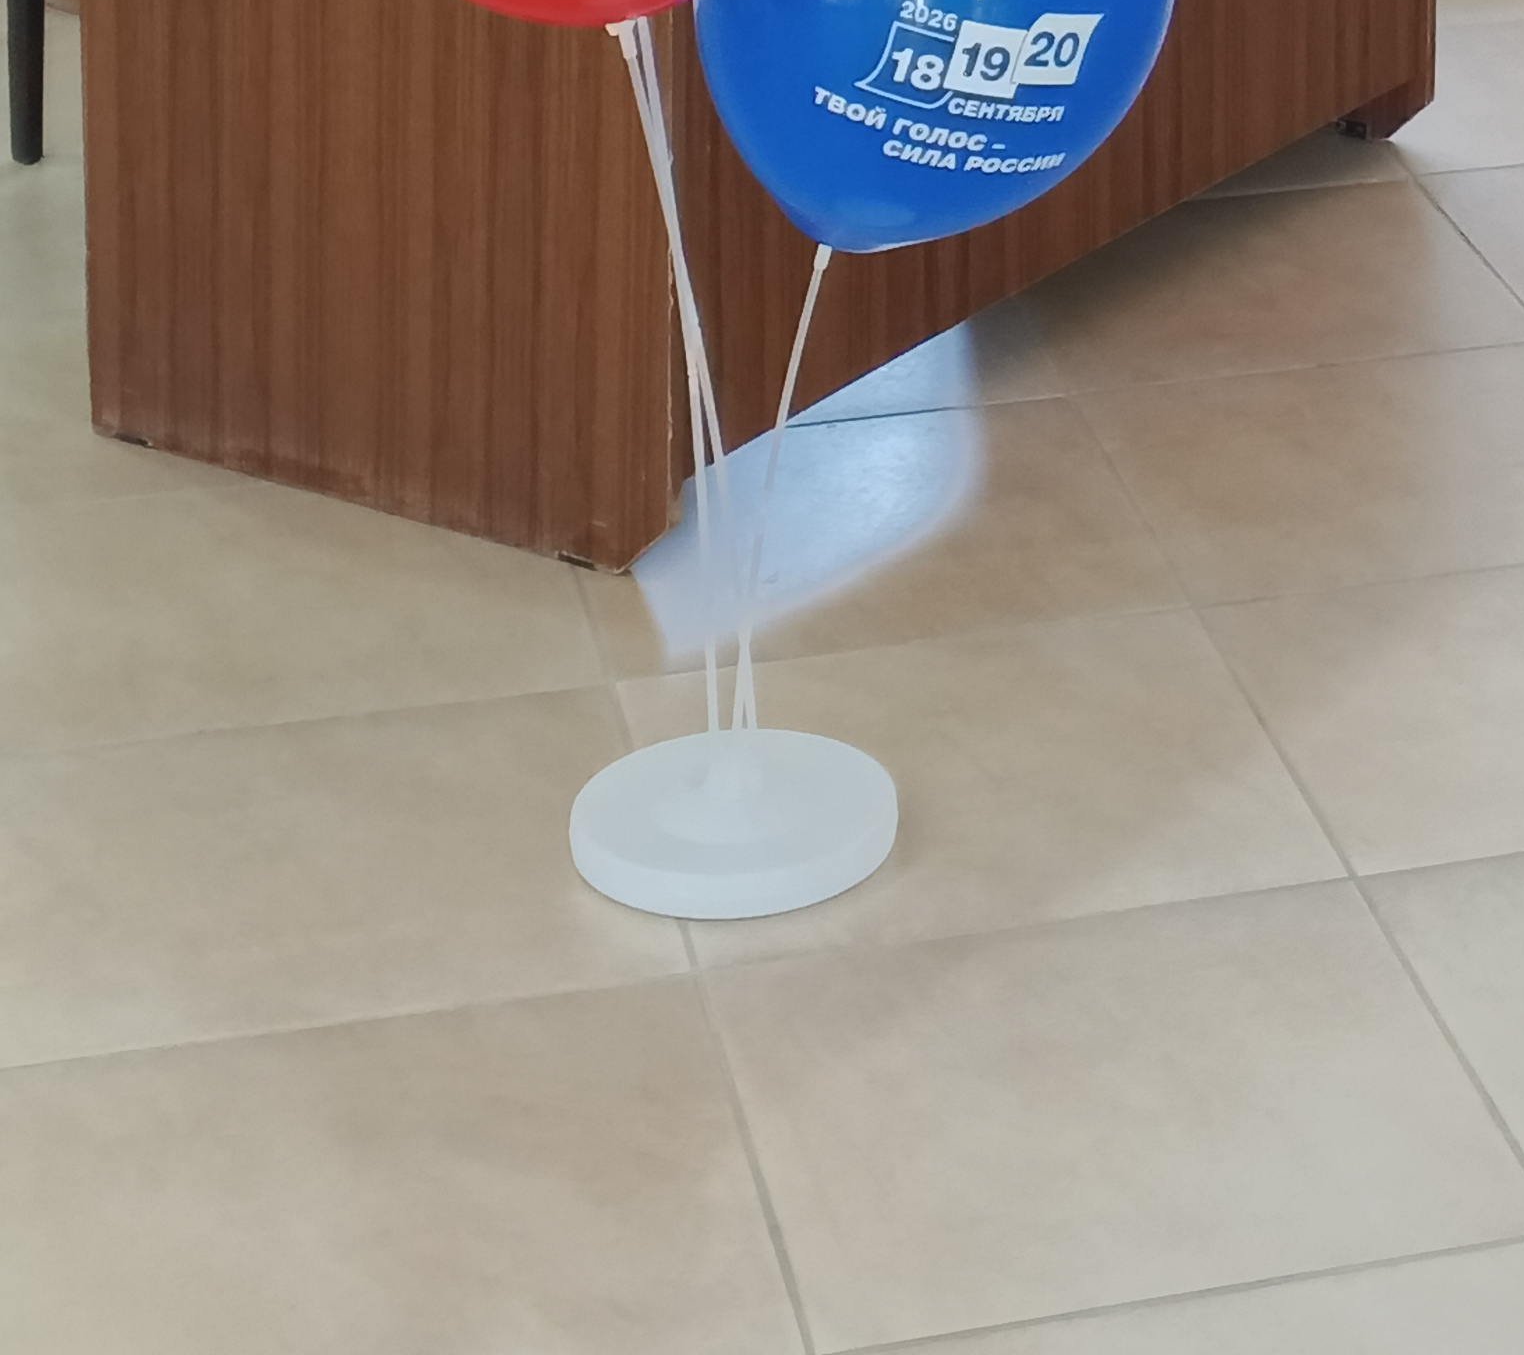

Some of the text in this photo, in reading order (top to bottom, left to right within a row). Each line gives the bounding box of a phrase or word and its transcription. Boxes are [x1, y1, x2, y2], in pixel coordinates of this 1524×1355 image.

[900, 1, 958, 32] 2026
[891, 31, 1080, 91] 18 19 20
[813, 87, 885, 129] ТВОЙ
[893, 119, 987, 152] ГОЛОС
[948, 96, 1065, 123] СЕНТЯБРЯ
[882, 141, 1065, 174] СИЛА РОССИИ
